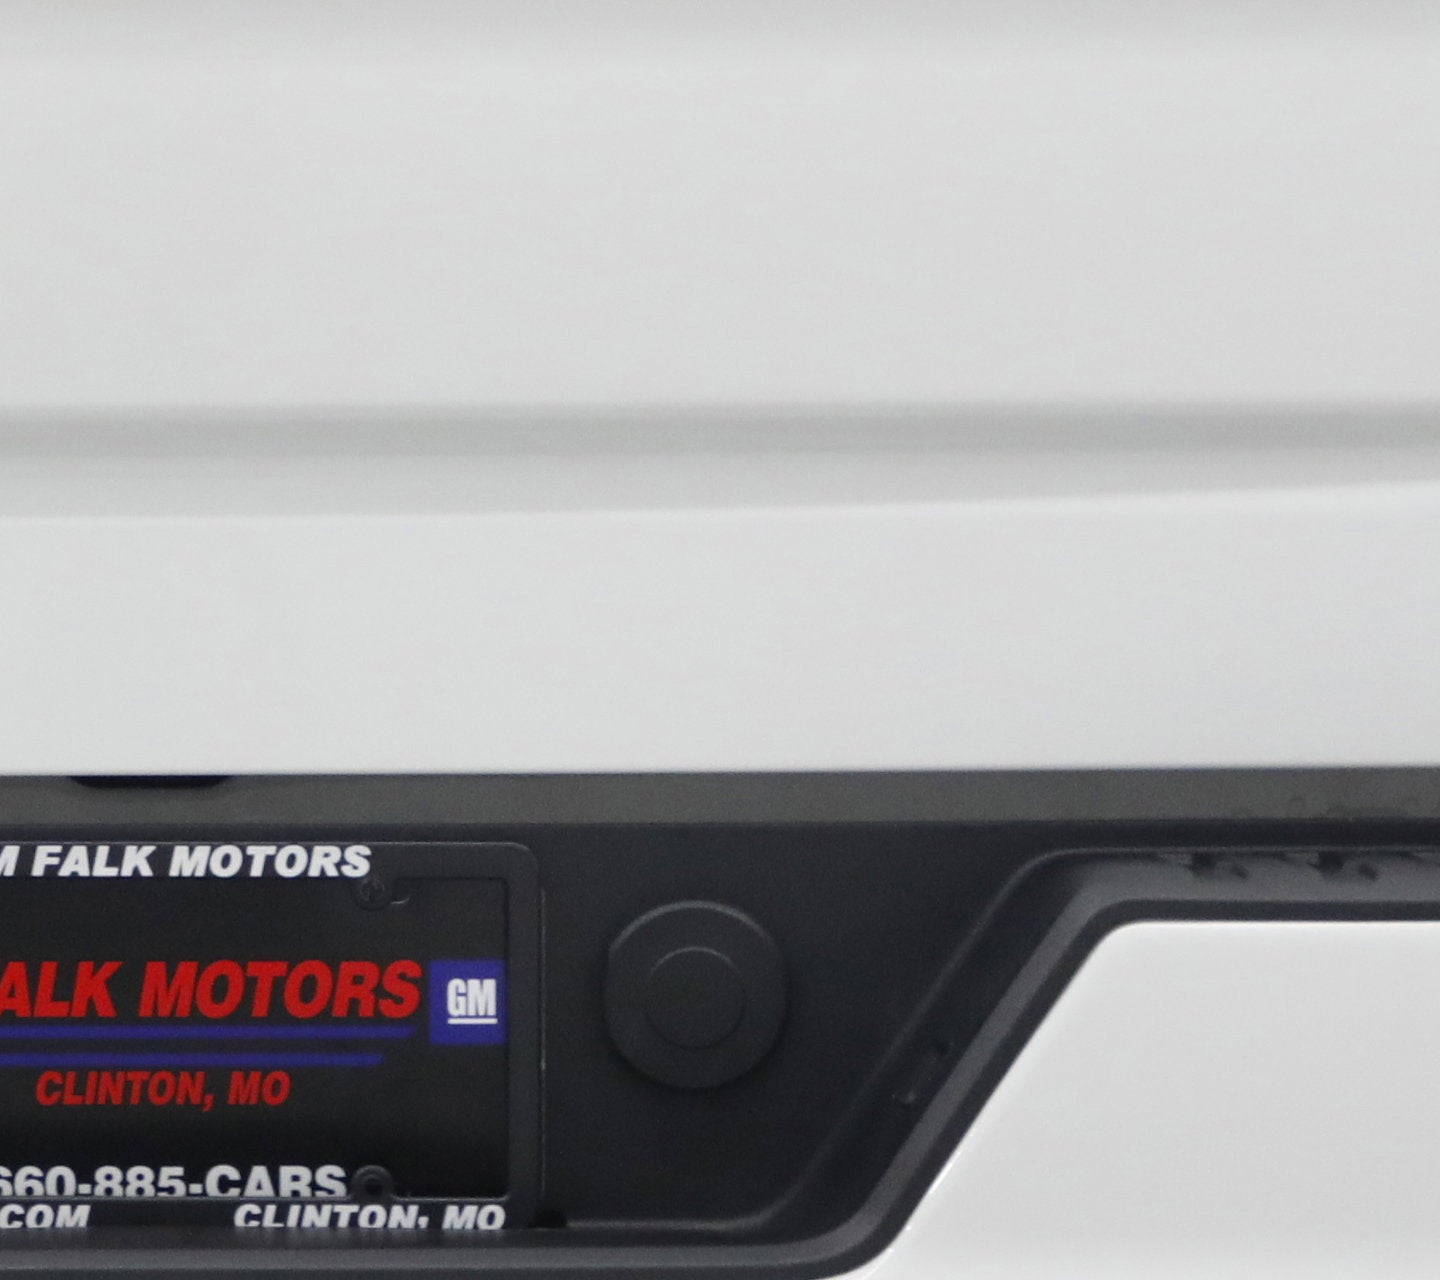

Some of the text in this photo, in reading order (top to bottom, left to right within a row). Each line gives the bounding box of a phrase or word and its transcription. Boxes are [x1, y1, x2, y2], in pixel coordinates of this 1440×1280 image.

[31, 844, 156, 878] FALK
[168, 844, 372, 878] MOTORS
[138, 959, 423, 1020] MOTORS
[446, 978, 498, 1017] GM
[35, 1070, 291, 1111] CLINTON, MO
[233, 1203, 506, 1231] CLINTON, MO
